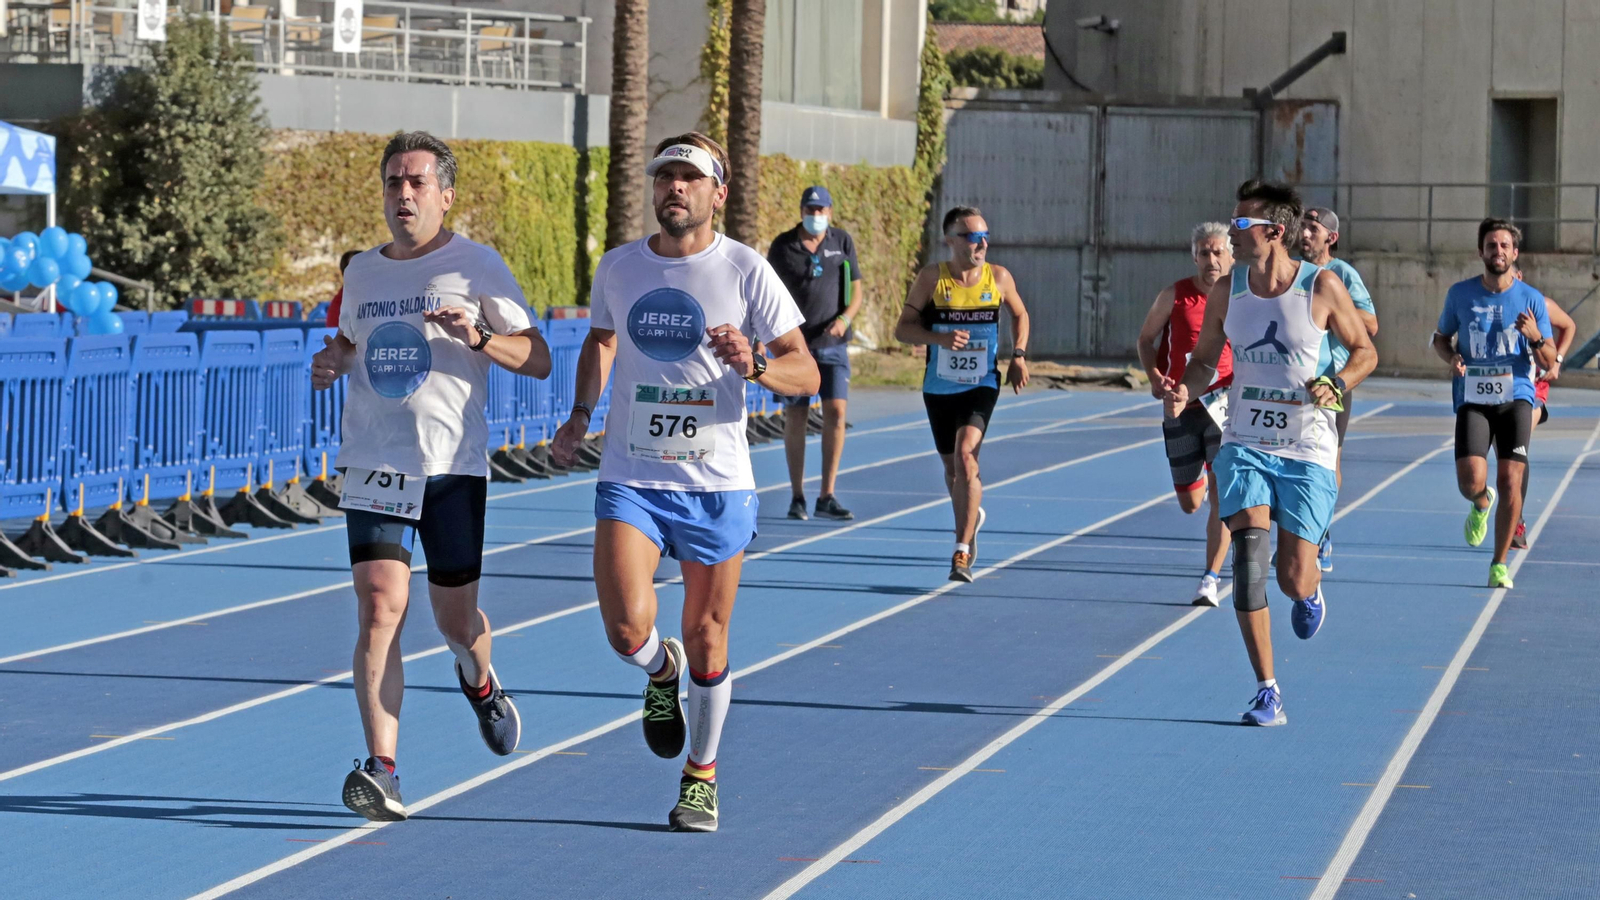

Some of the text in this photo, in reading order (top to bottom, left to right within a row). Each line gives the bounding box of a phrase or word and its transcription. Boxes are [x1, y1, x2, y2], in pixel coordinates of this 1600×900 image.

[357, 292, 441, 320] ANTONIO SALDAÑA
[638, 312, 693, 327] JEREZ
[948, 311, 994, 321] MOVIJEREZ
[637, 328, 692, 339] CAPPITAL
[370, 347, 419, 361] JEREZ
[371, 364, 419, 373] CAPPITAL
[949, 356, 978, 371] 325
[1476, 382, 1503, 395] 593
[648, 413, 698, 439] 576
[1250, 408, 1288, 430] 753
